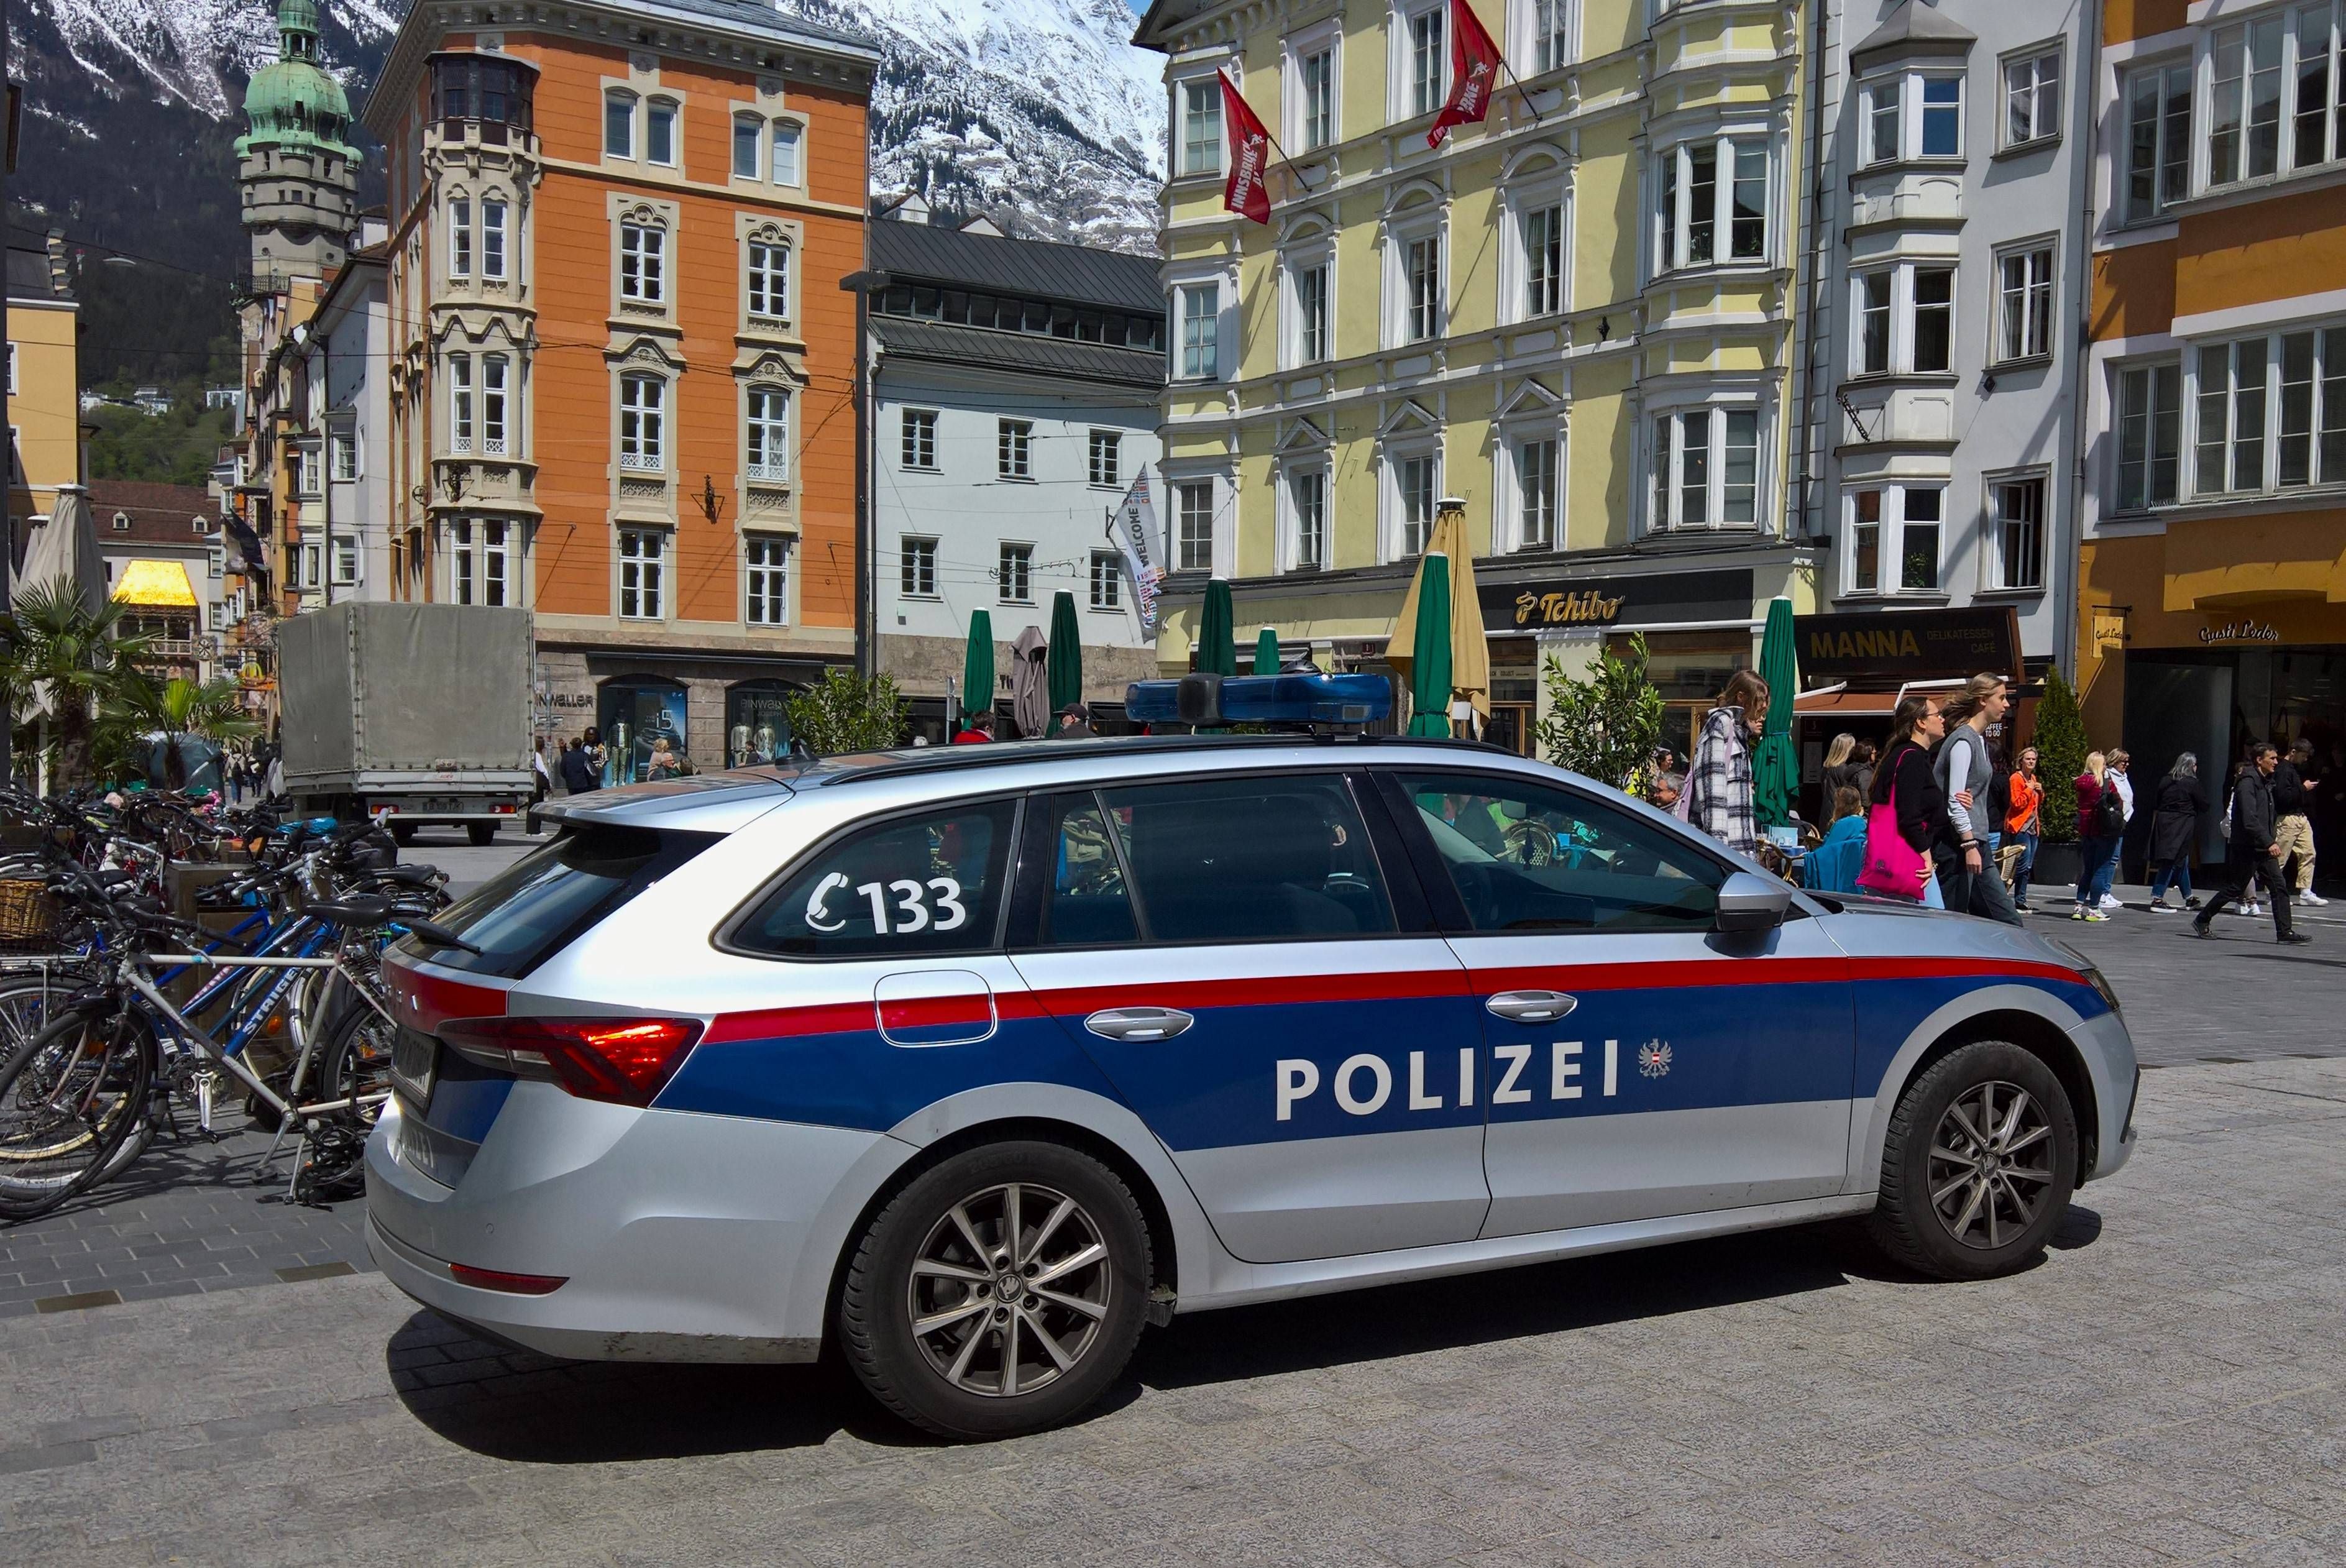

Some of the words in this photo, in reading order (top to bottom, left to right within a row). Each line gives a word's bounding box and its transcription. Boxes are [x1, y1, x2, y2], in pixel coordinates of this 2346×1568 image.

[1128, 507, 1149, 567] WELCOME
[1539, 590, 1626, 622] Tchibo
[1811, 630, 1922, 658] MANNA
[1927, 628, 1995, 641] DELIKATESSEN
[1971, 641, 1997, 654] CAFÉ
[2199, 623, 2237, 644] Gusti
[2237, 619, 2278, 641] Leder
[856, 877, 966, 934] 133
[242, 967, 300, 1035] STAIGE
[1276, 1039, 1618, 1121] POLIZEI
